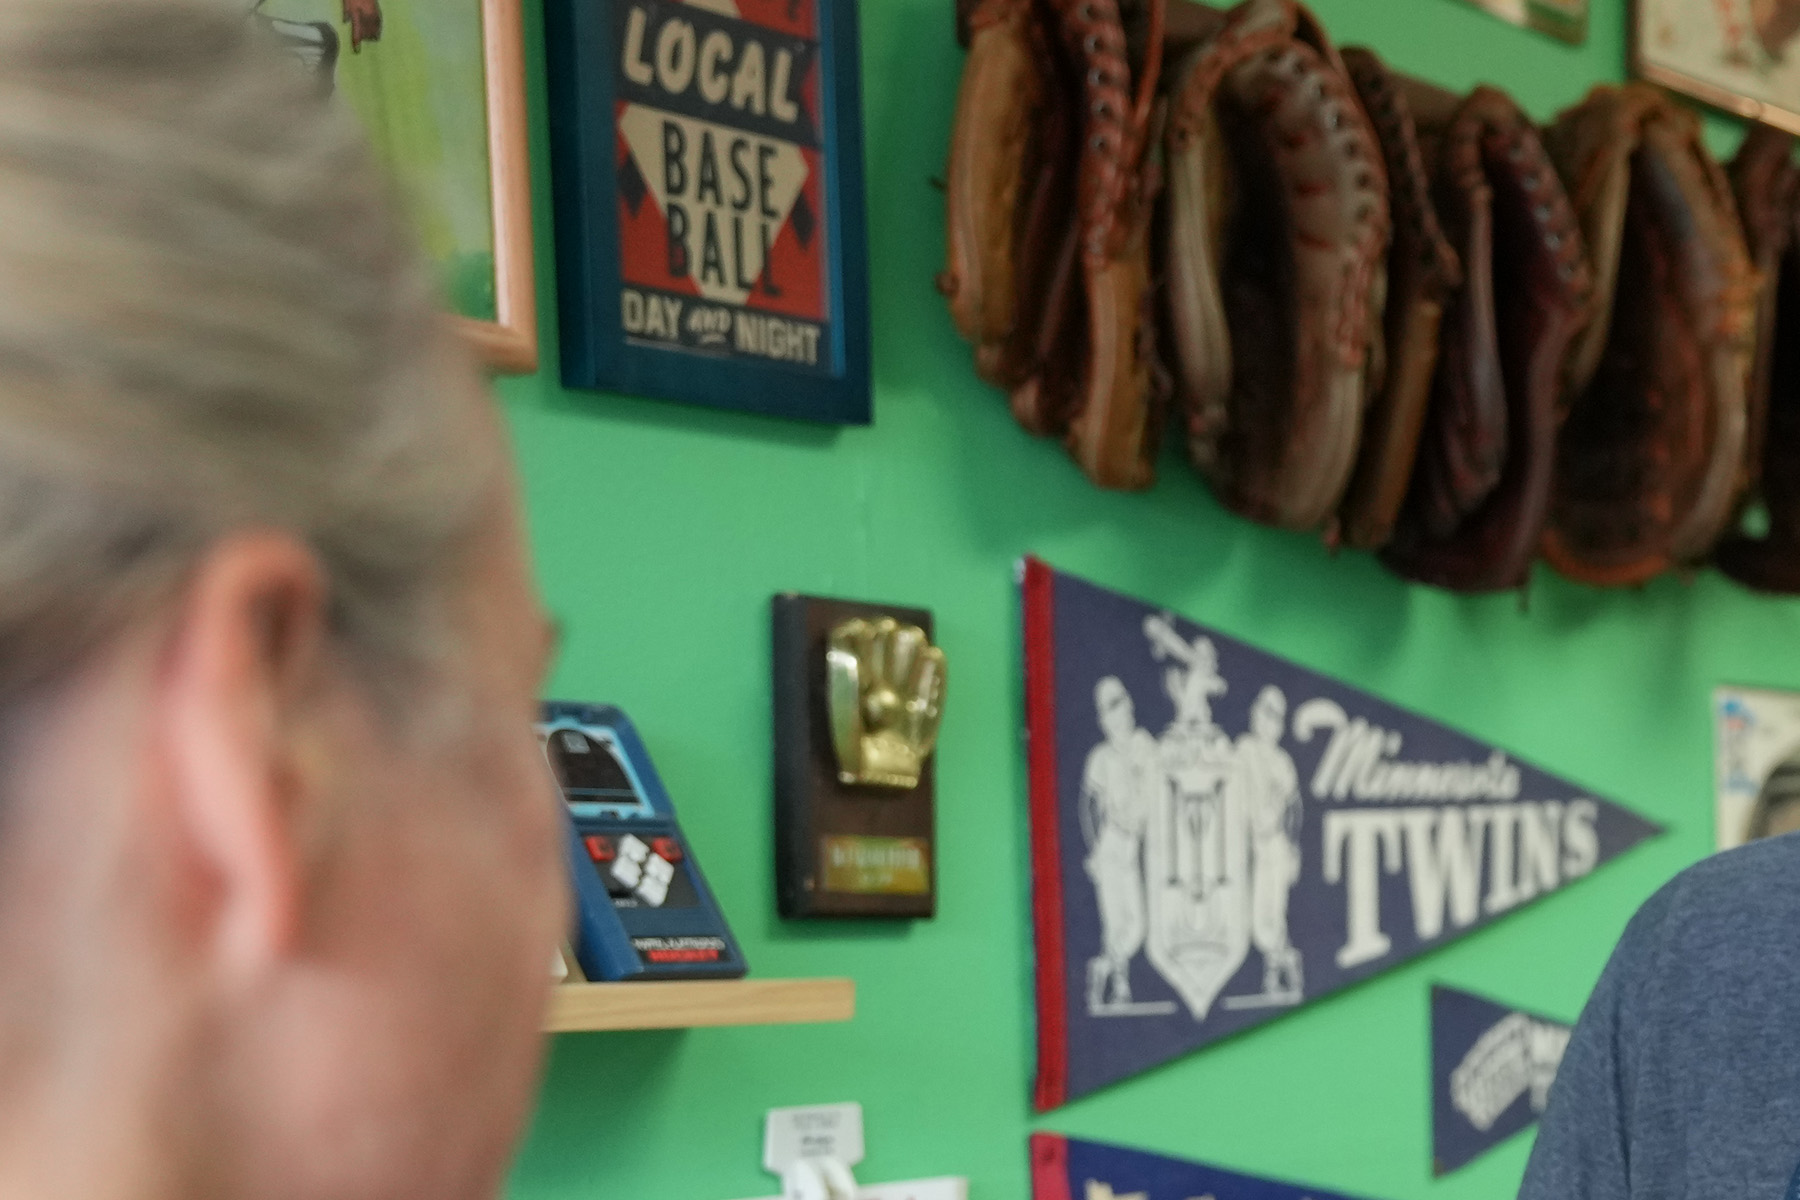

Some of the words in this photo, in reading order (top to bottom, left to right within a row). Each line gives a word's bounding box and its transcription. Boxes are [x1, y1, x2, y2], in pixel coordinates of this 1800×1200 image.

[622, 6, 798, 123] LOCAL
[662, 119, 779, 219] BASE
[667, 203, 781, 296] BALL
[621, 289, 682, 340] DAY
[734, 311, 821, 365] NIGHT
[1294, 699, 1520, 801] Minnesota
[1322, 800, 1599, 968] TWINS
